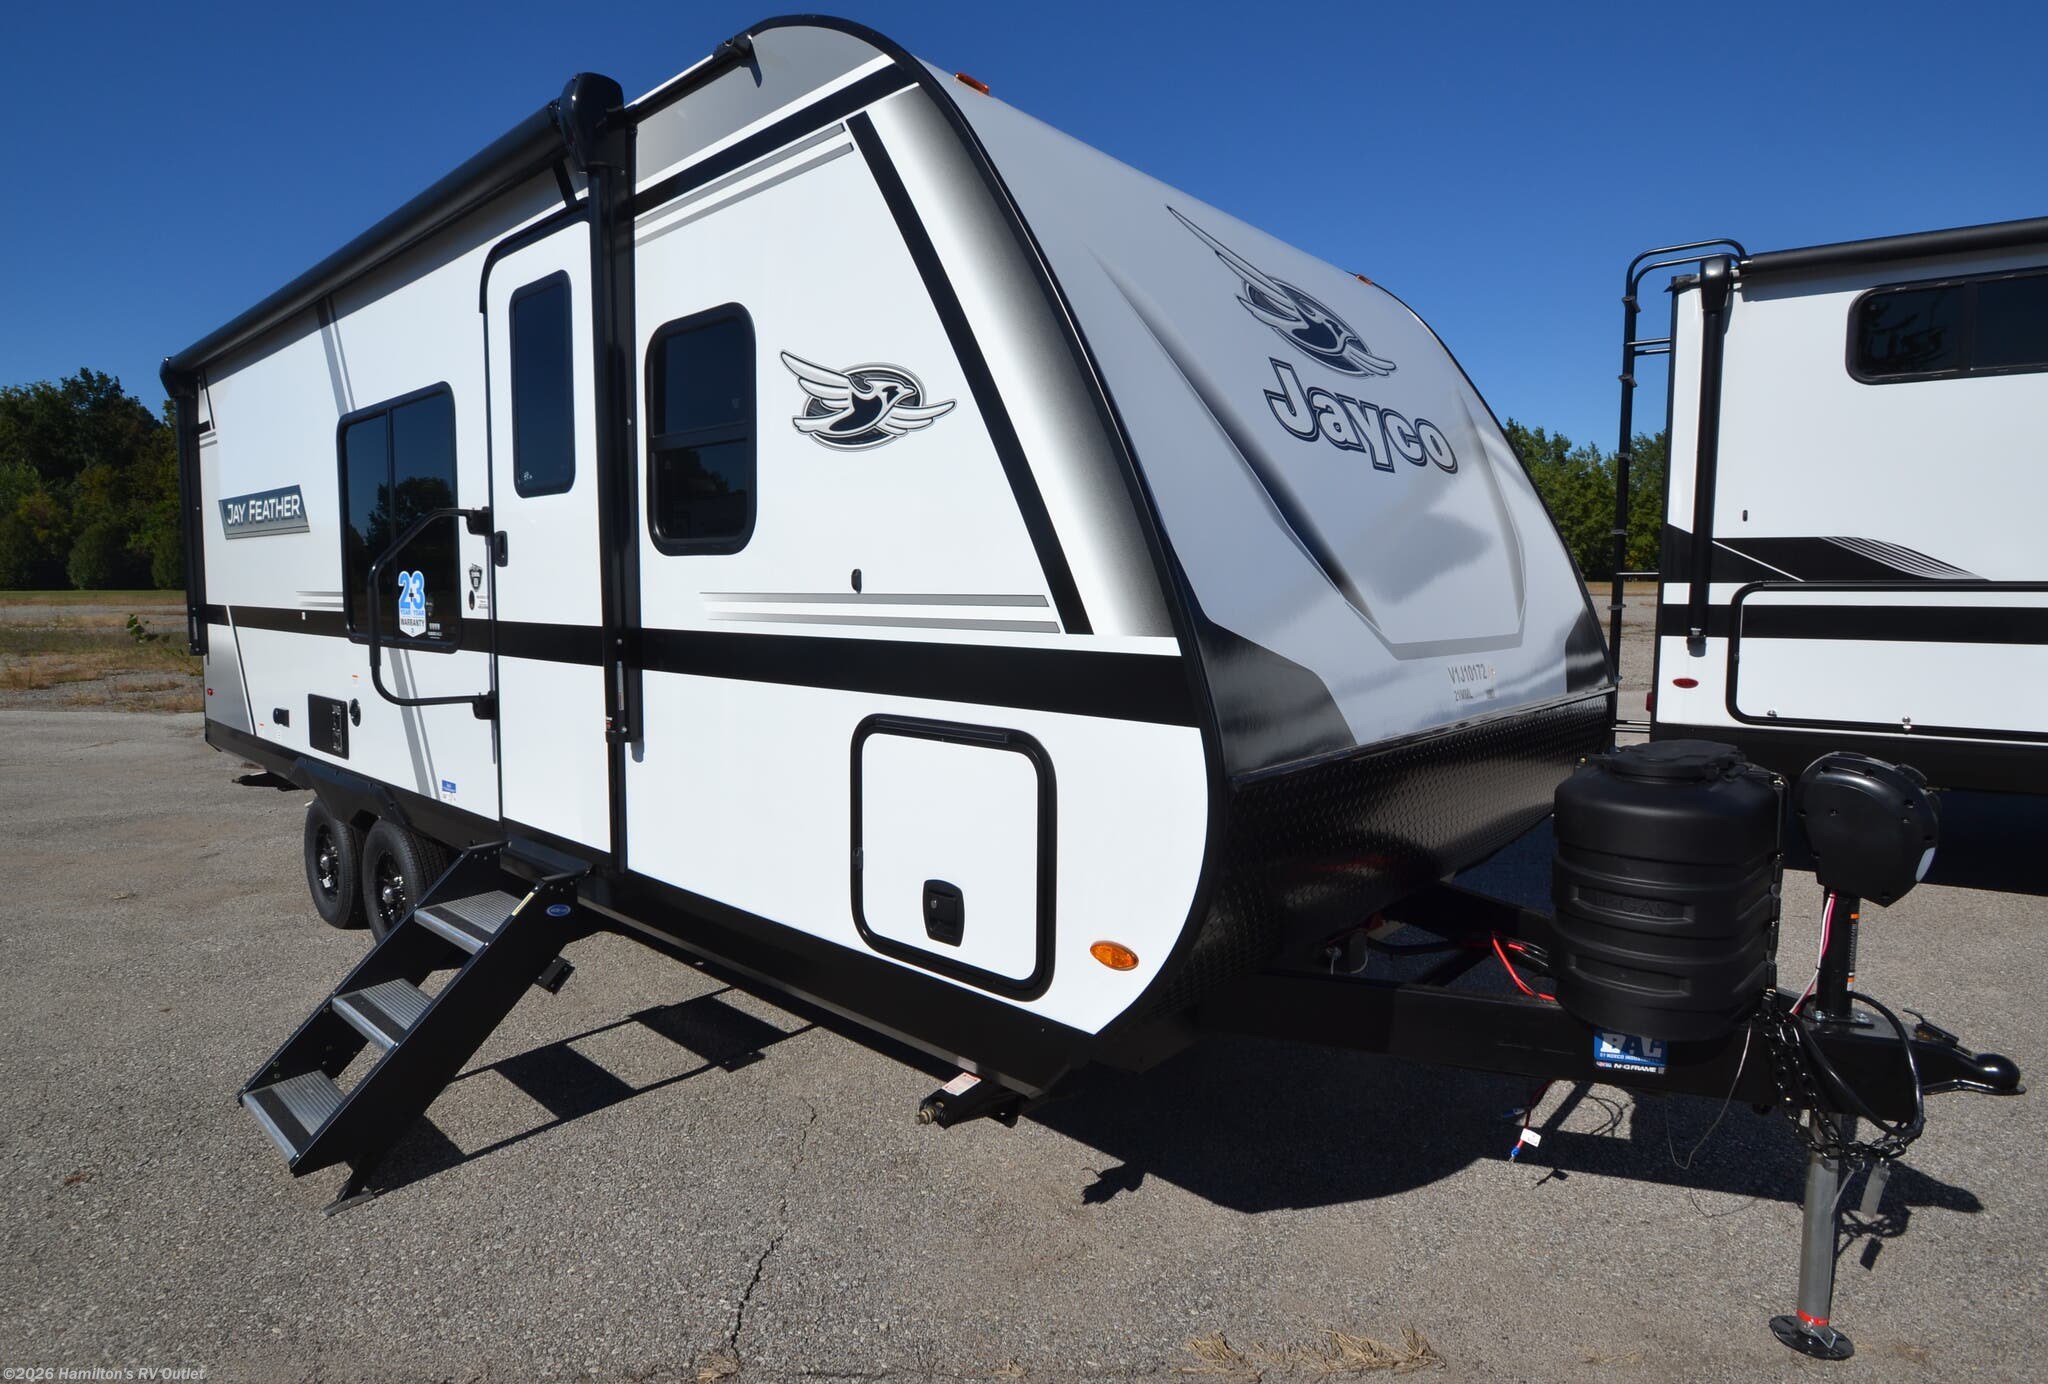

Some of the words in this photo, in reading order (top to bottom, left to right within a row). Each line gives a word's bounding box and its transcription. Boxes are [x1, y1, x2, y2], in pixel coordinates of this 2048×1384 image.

[1263, 357, 1458, 474] Jayco
[227, 503, 246, 525] JAY
[249, 494, 301, 522] FEATHER
[401, 618, 425, 627] WARRANTY
